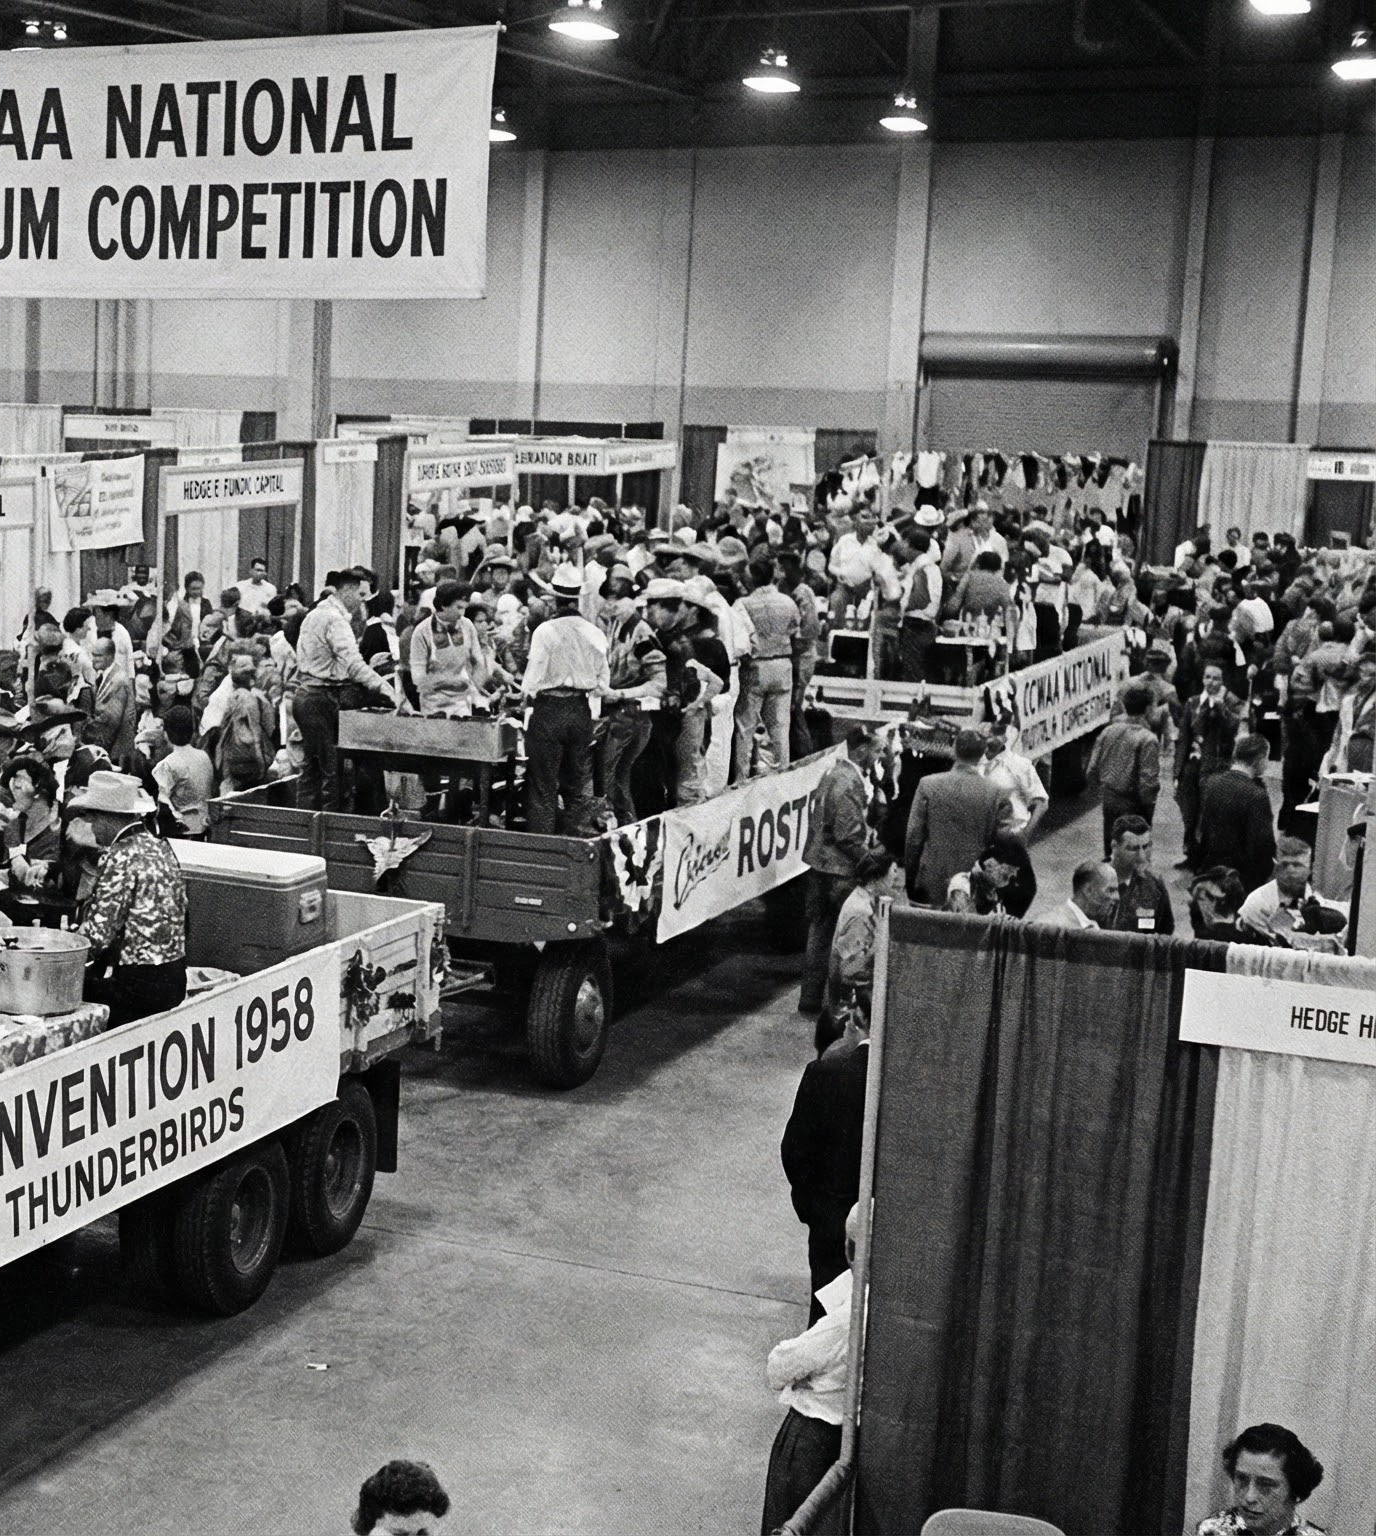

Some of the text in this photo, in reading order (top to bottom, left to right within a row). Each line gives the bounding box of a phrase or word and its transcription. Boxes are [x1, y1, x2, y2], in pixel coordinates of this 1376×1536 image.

[105, 72, 414, 159] NATIONAL
[87, 178, 448, 261] COMPETITION
[234, 976, 314, 1070] 1958
[1290, 1006, 1376, 1039] HEDGE H
[5, 1086, 244, 1237] THUNDERBIRDS
